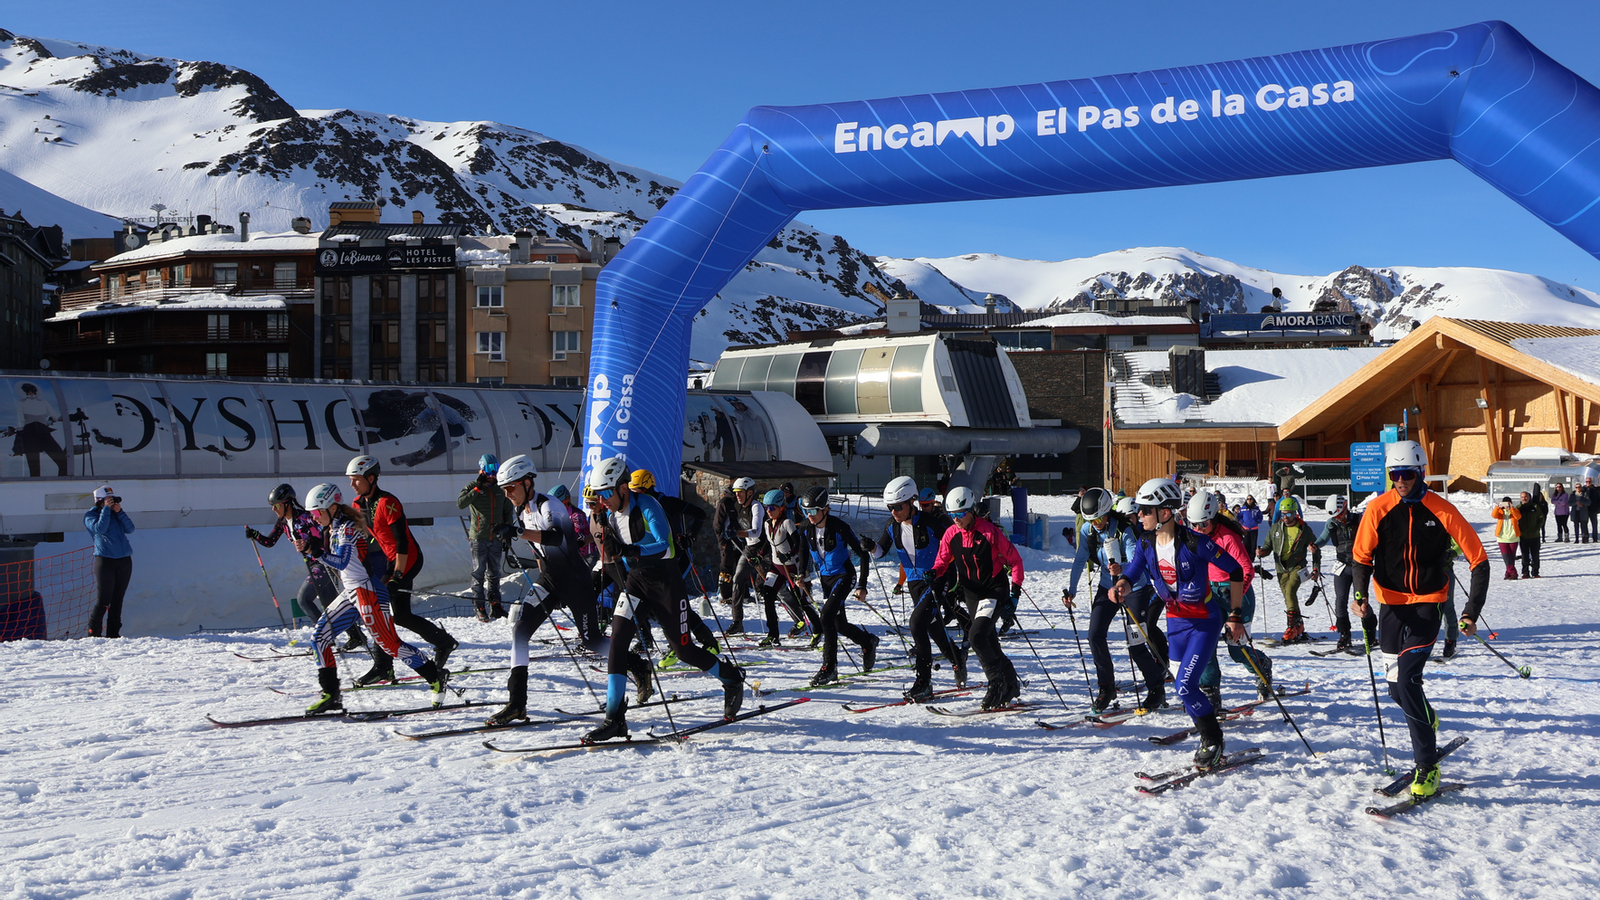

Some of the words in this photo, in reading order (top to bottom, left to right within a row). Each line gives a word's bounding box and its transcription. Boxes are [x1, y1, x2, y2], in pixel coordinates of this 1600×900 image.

[834, 113, 1015, 153] Encamp
[1037, 106, 1067, 136] El
[1078, 105, 1140, 132] Pas
[1150, 96, 1199, 124] de
[1211, 89, 1245, 117] la
[1255, 80, 1355, 112] Casa
[1131, 631, 1139, 639] 16
[1180, 654, 1199, 685] Andorra
